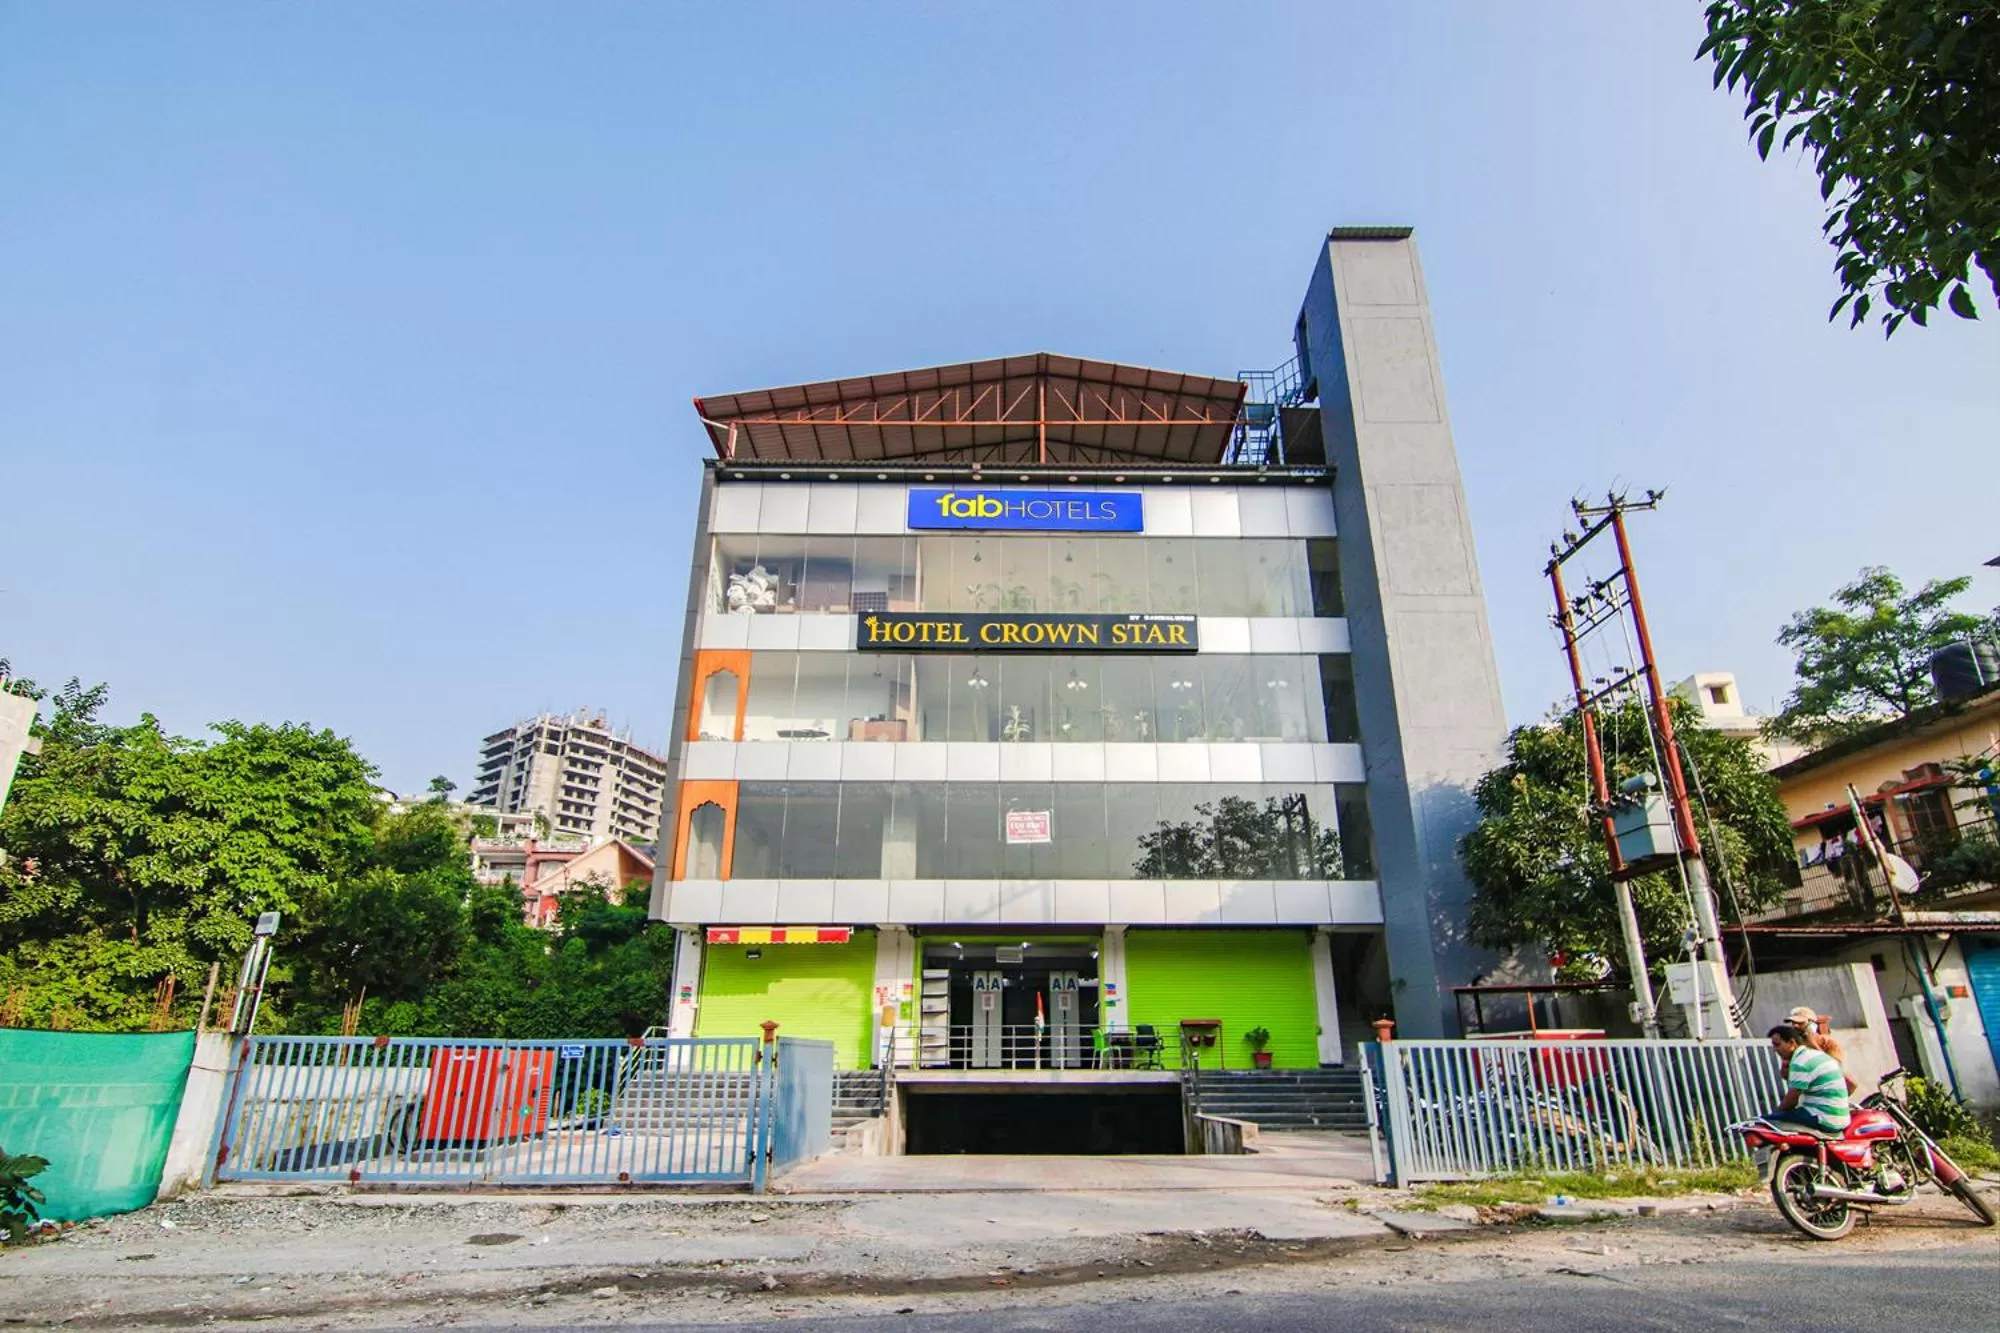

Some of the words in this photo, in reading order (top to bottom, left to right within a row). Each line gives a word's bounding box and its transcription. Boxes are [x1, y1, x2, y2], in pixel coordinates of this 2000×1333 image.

[867, 620, 970, 643] HOTEL
[980, 621, 1099, 644] CROWN
[1111, 622, 1189, 645] STAR
[975, 977, 985, 990] A
[990, 977, 1000, 990] A
[1052, 977, 1061, 990] A
[1066, 977, 1076, 990] A
